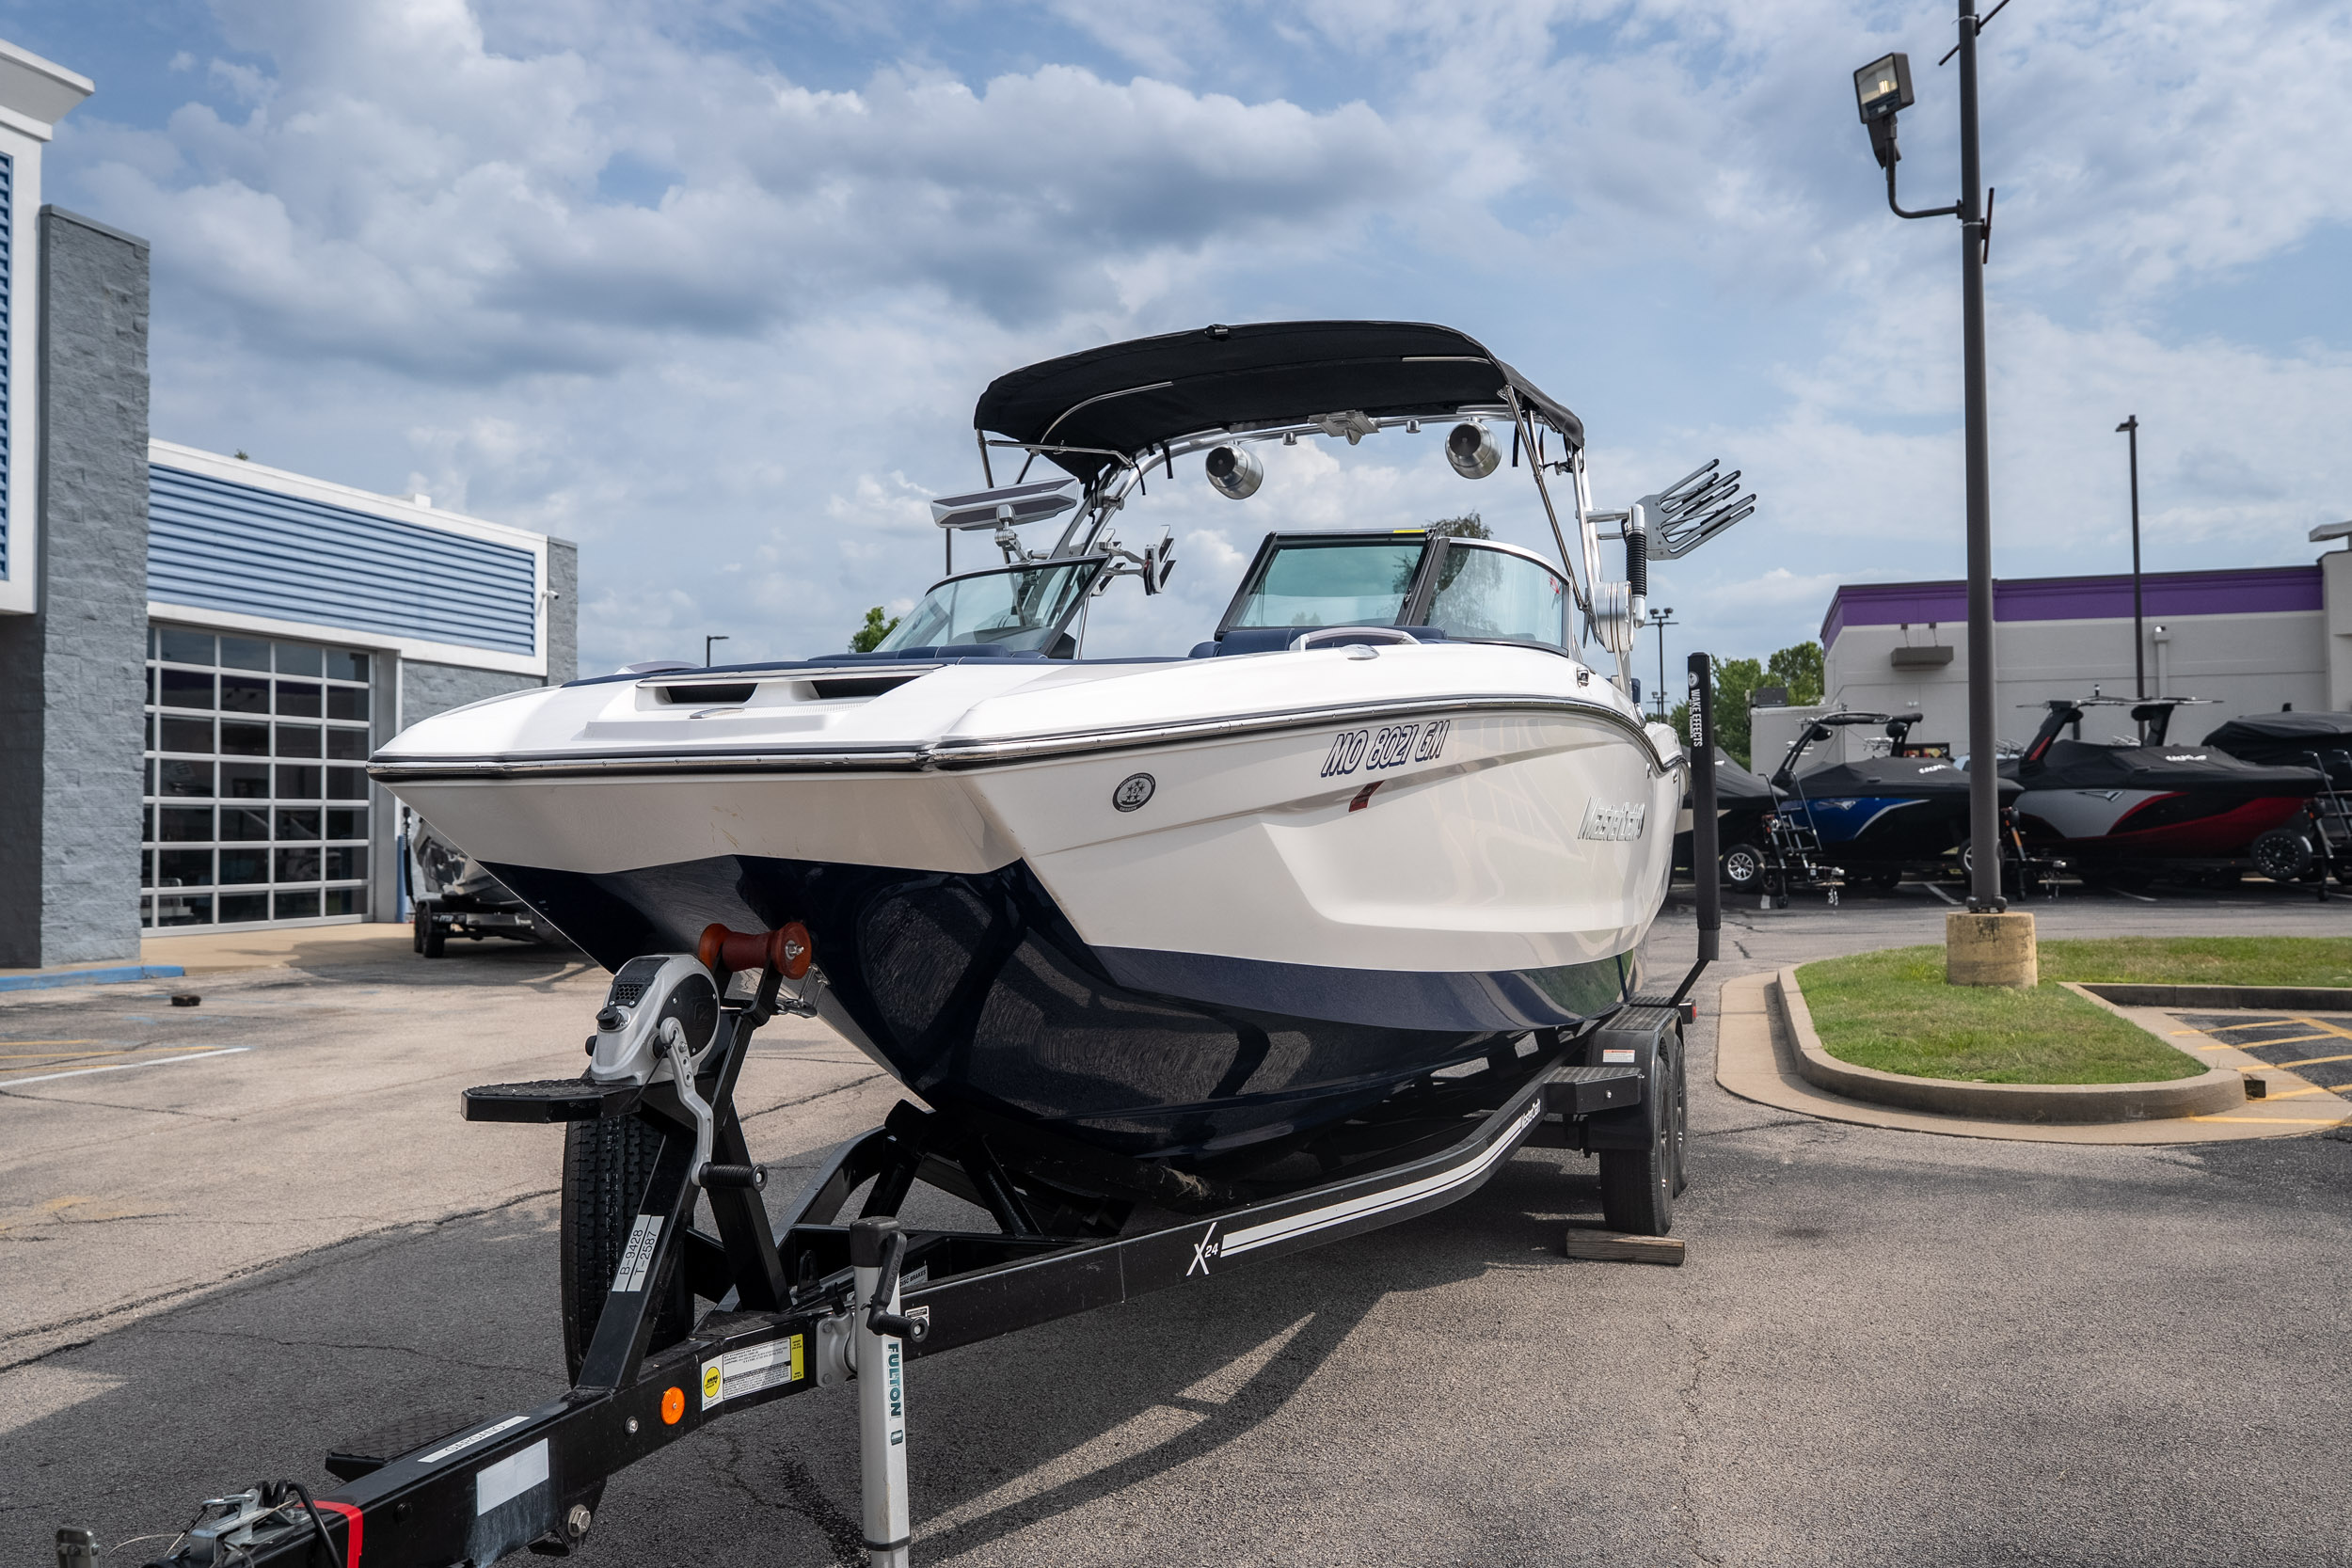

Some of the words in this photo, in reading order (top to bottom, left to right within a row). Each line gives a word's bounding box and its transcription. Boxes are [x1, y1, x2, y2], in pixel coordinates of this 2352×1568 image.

[1691, 689, 1701, 712] WAKE
[1320, 730, 1369, 778] MO
[1366, 723, 1420, 770] 8021
[1415, 720, 1450, 763] GM
[1693, 713, 1703, 747] EFFECTS
[620, 1229, 643, 1275] B-9428
[634, 1230, 657, 1275] T-2587
[910, 1269, 927, 1282] BRAKES
[887, 1342, 902, 1418] FULTON
